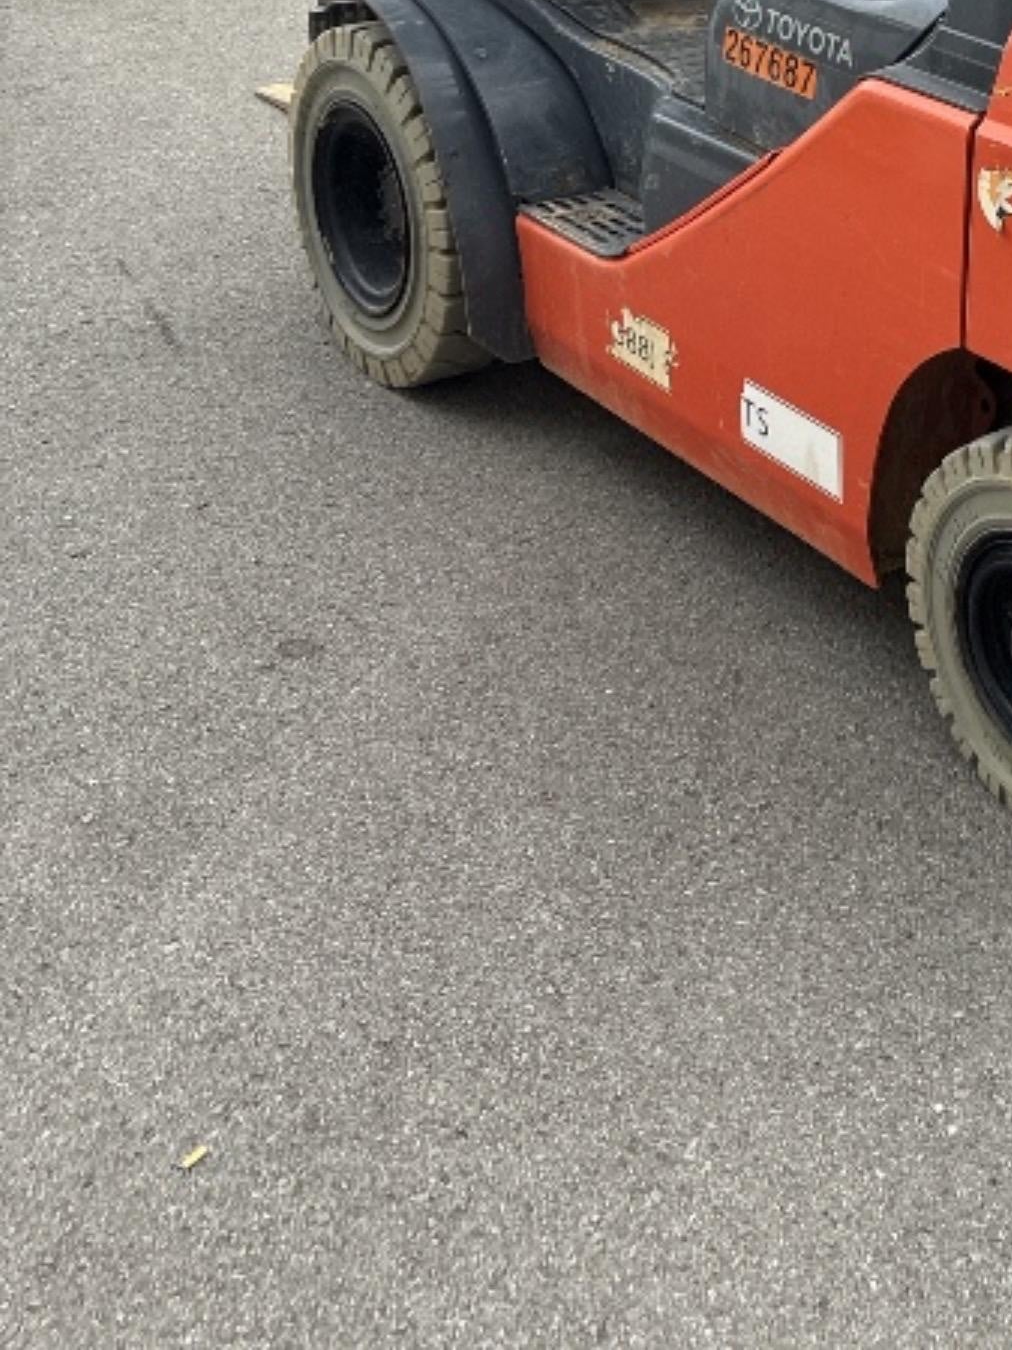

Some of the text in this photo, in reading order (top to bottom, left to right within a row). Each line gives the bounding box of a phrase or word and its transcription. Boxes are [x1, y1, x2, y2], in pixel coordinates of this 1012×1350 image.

[723, 29, 817, 93] 267687
[766, 8, 853, 68] TOYOTA
[743, 399, 769, 437] TS
